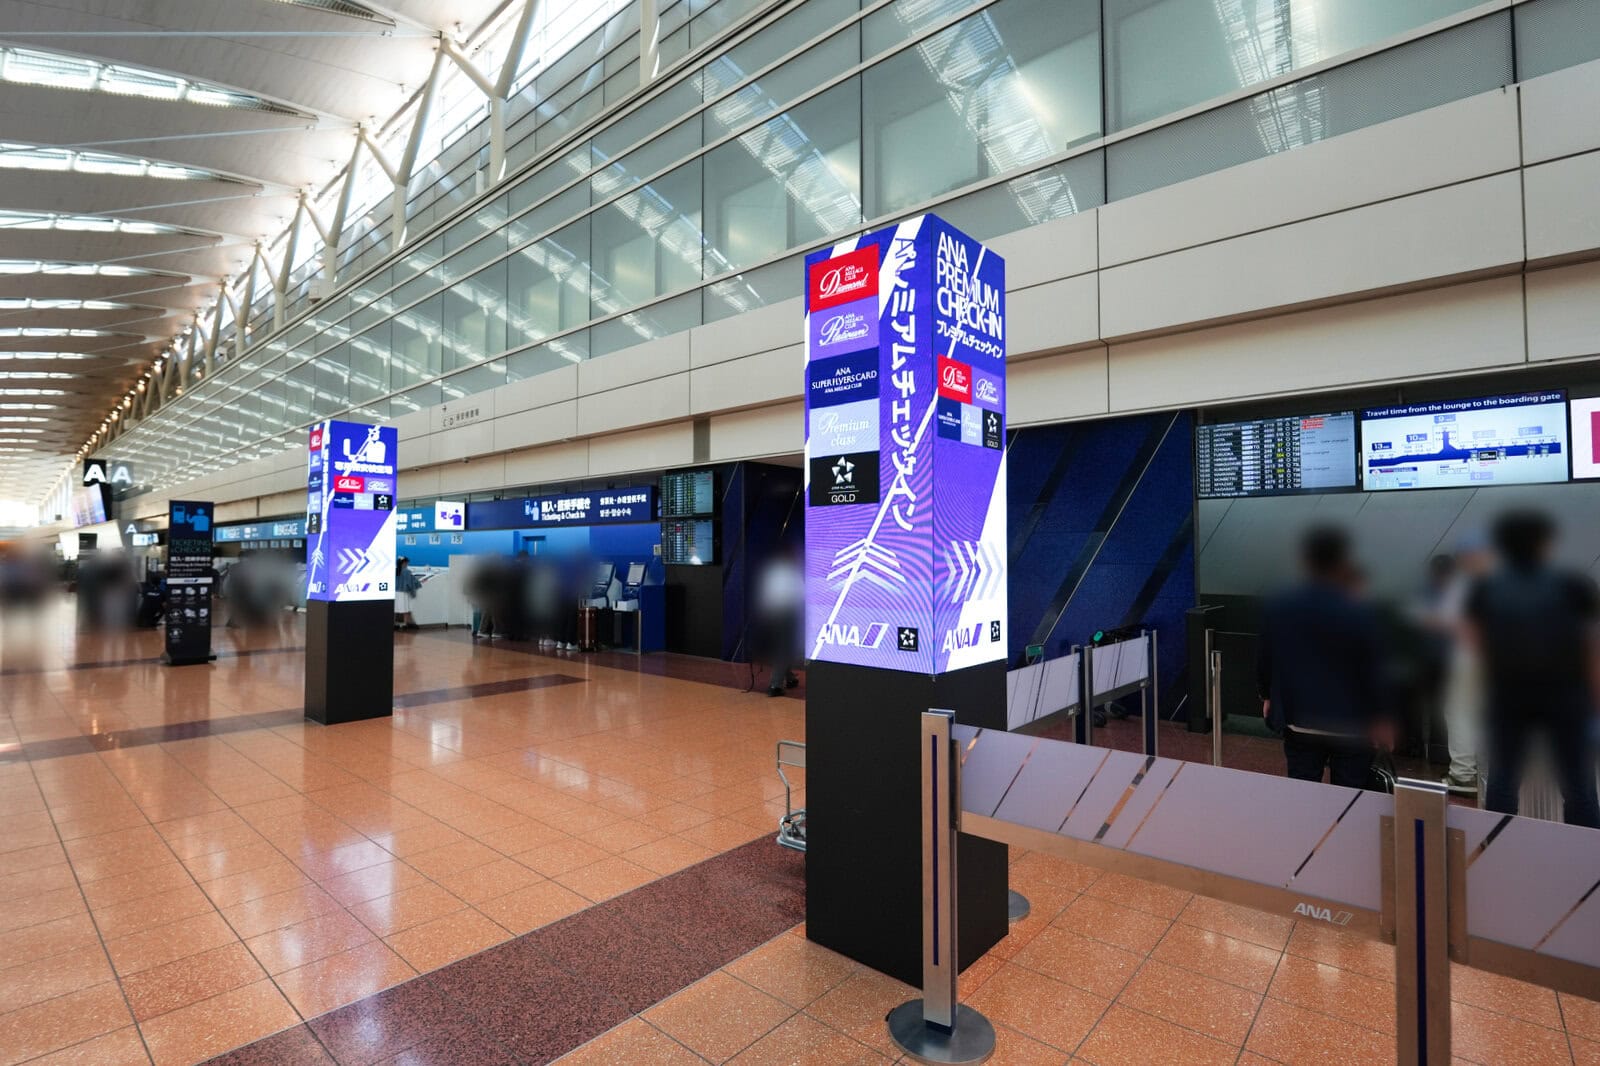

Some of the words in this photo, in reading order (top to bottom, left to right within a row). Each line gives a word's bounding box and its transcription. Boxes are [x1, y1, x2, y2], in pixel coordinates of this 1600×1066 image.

[937, 231, 969, 273] ANA
[819, 266, 869, 299] Diamond
[937, 256, 999, 315] PREMIUM
[936, 286, 1002, 341] CHECK-IN
[819, 315, 869, 346] Platinum
[936, 319, 1003, 359] プレミアムチェックイン
[812, 378, 831, 390] SUPER
[830, 374, 856, 387] FLYERS
[855, 370, 877, 382] CARD
[835, 367, 851, 376] ANA
[1367, 408, 1389, 417] Travel
[1390, 406, 1408, 415] time
[1408, 405, 1428, 413] from
[1428, 403, 1442, 411] the
[1443, 401, 1472, 411] lounge
[1473, 398, 1482, 407] to
[1483, 397, 1498, 406] the
[1499, 394, 1539, 405] boarding
[1540, 393, 1561, 403] gate
[818, 412, 870, 436] Premium
[831, 434, 857, 447] class
[987, 439, 999, 448] GOLD
[84, 464, 106, 482] A
[111, 466, 132, 483] A
[831, 494, 856, 503] GOLD
[541, 512, 561, 521] Ticketing
[565, 511, 579, 519] Check
[126, 524, 137, 534] A
[816, 624, 861, 647] ANA
[942, 626, 971, 654] ANA
[1293, 903, 1332, 922] ANA
